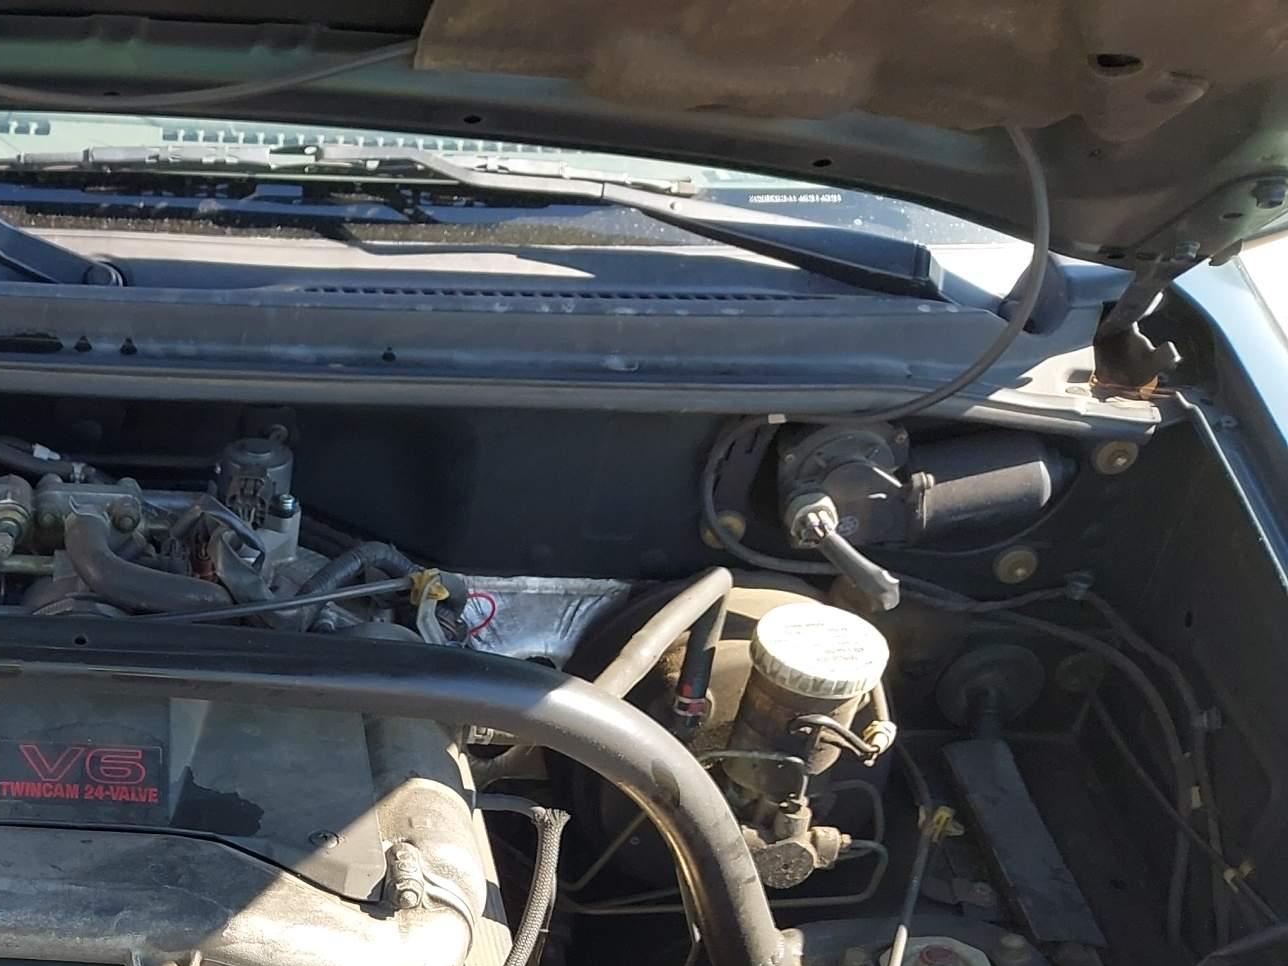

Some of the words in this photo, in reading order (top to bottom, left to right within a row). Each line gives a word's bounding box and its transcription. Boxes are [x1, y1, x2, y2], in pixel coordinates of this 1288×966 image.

[19, 744, 146, 784] V6
[0, 780, 79, 800] TWINCAM
[84, 784, 159, 804] 24-VALVE
